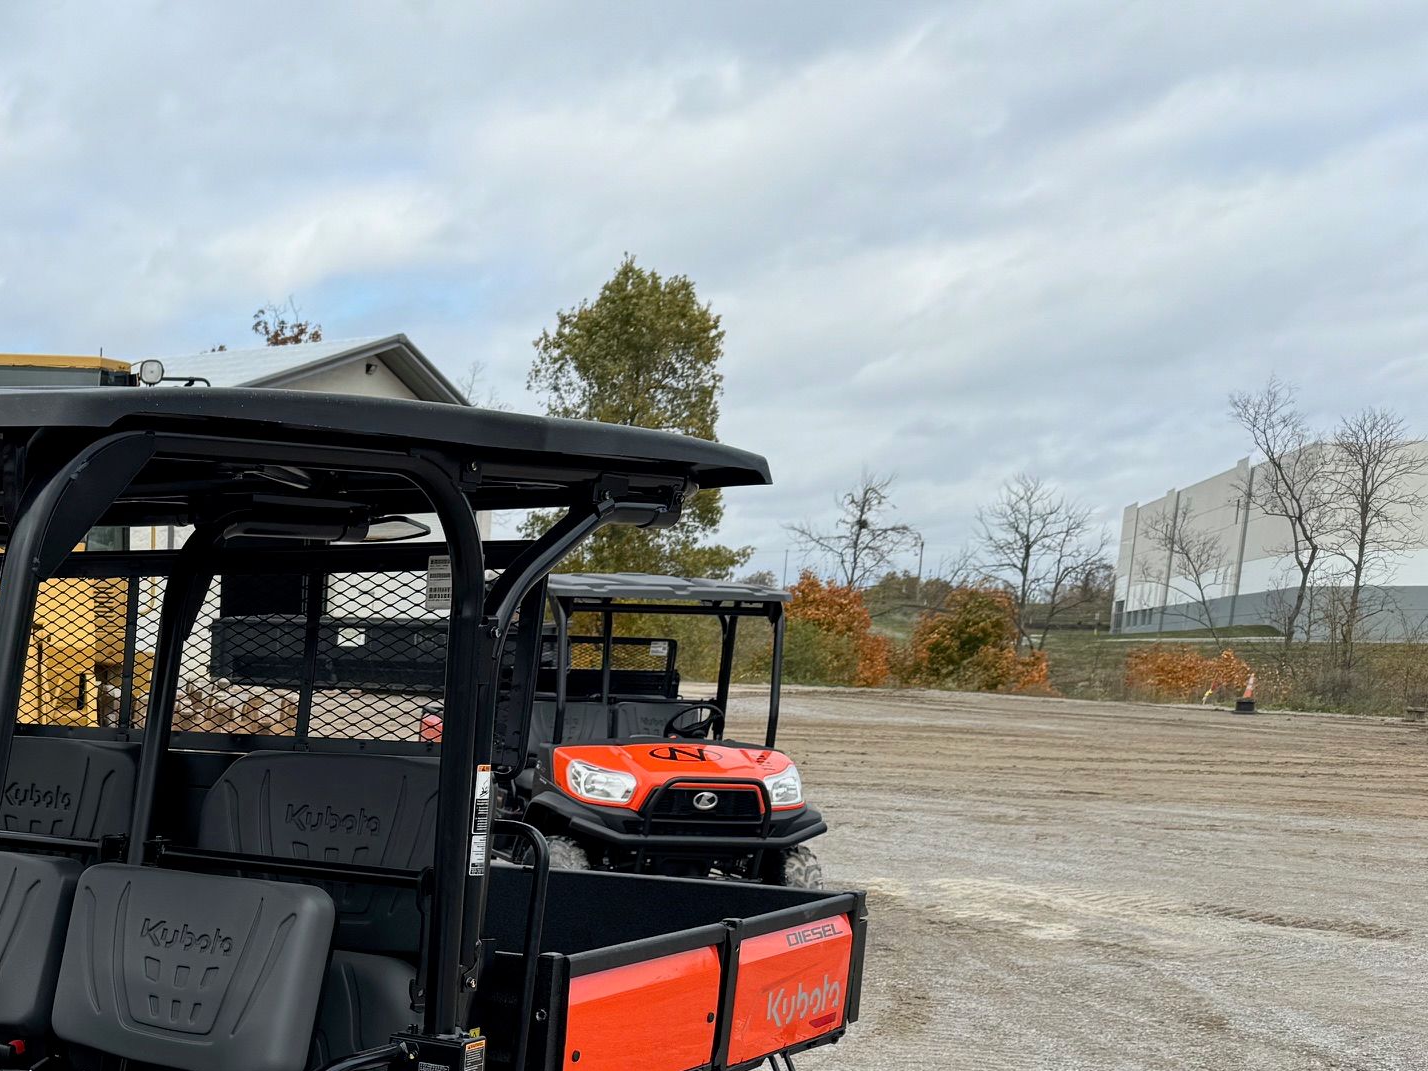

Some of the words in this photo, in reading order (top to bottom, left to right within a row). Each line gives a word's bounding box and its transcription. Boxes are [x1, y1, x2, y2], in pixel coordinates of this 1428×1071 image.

[285, 803, 381, 836] Kubota
[140, 917, 234, 957] Kubota
[785, 923, 844, 948] DIESEL
[766, 973, 841, 1028] Kubota
